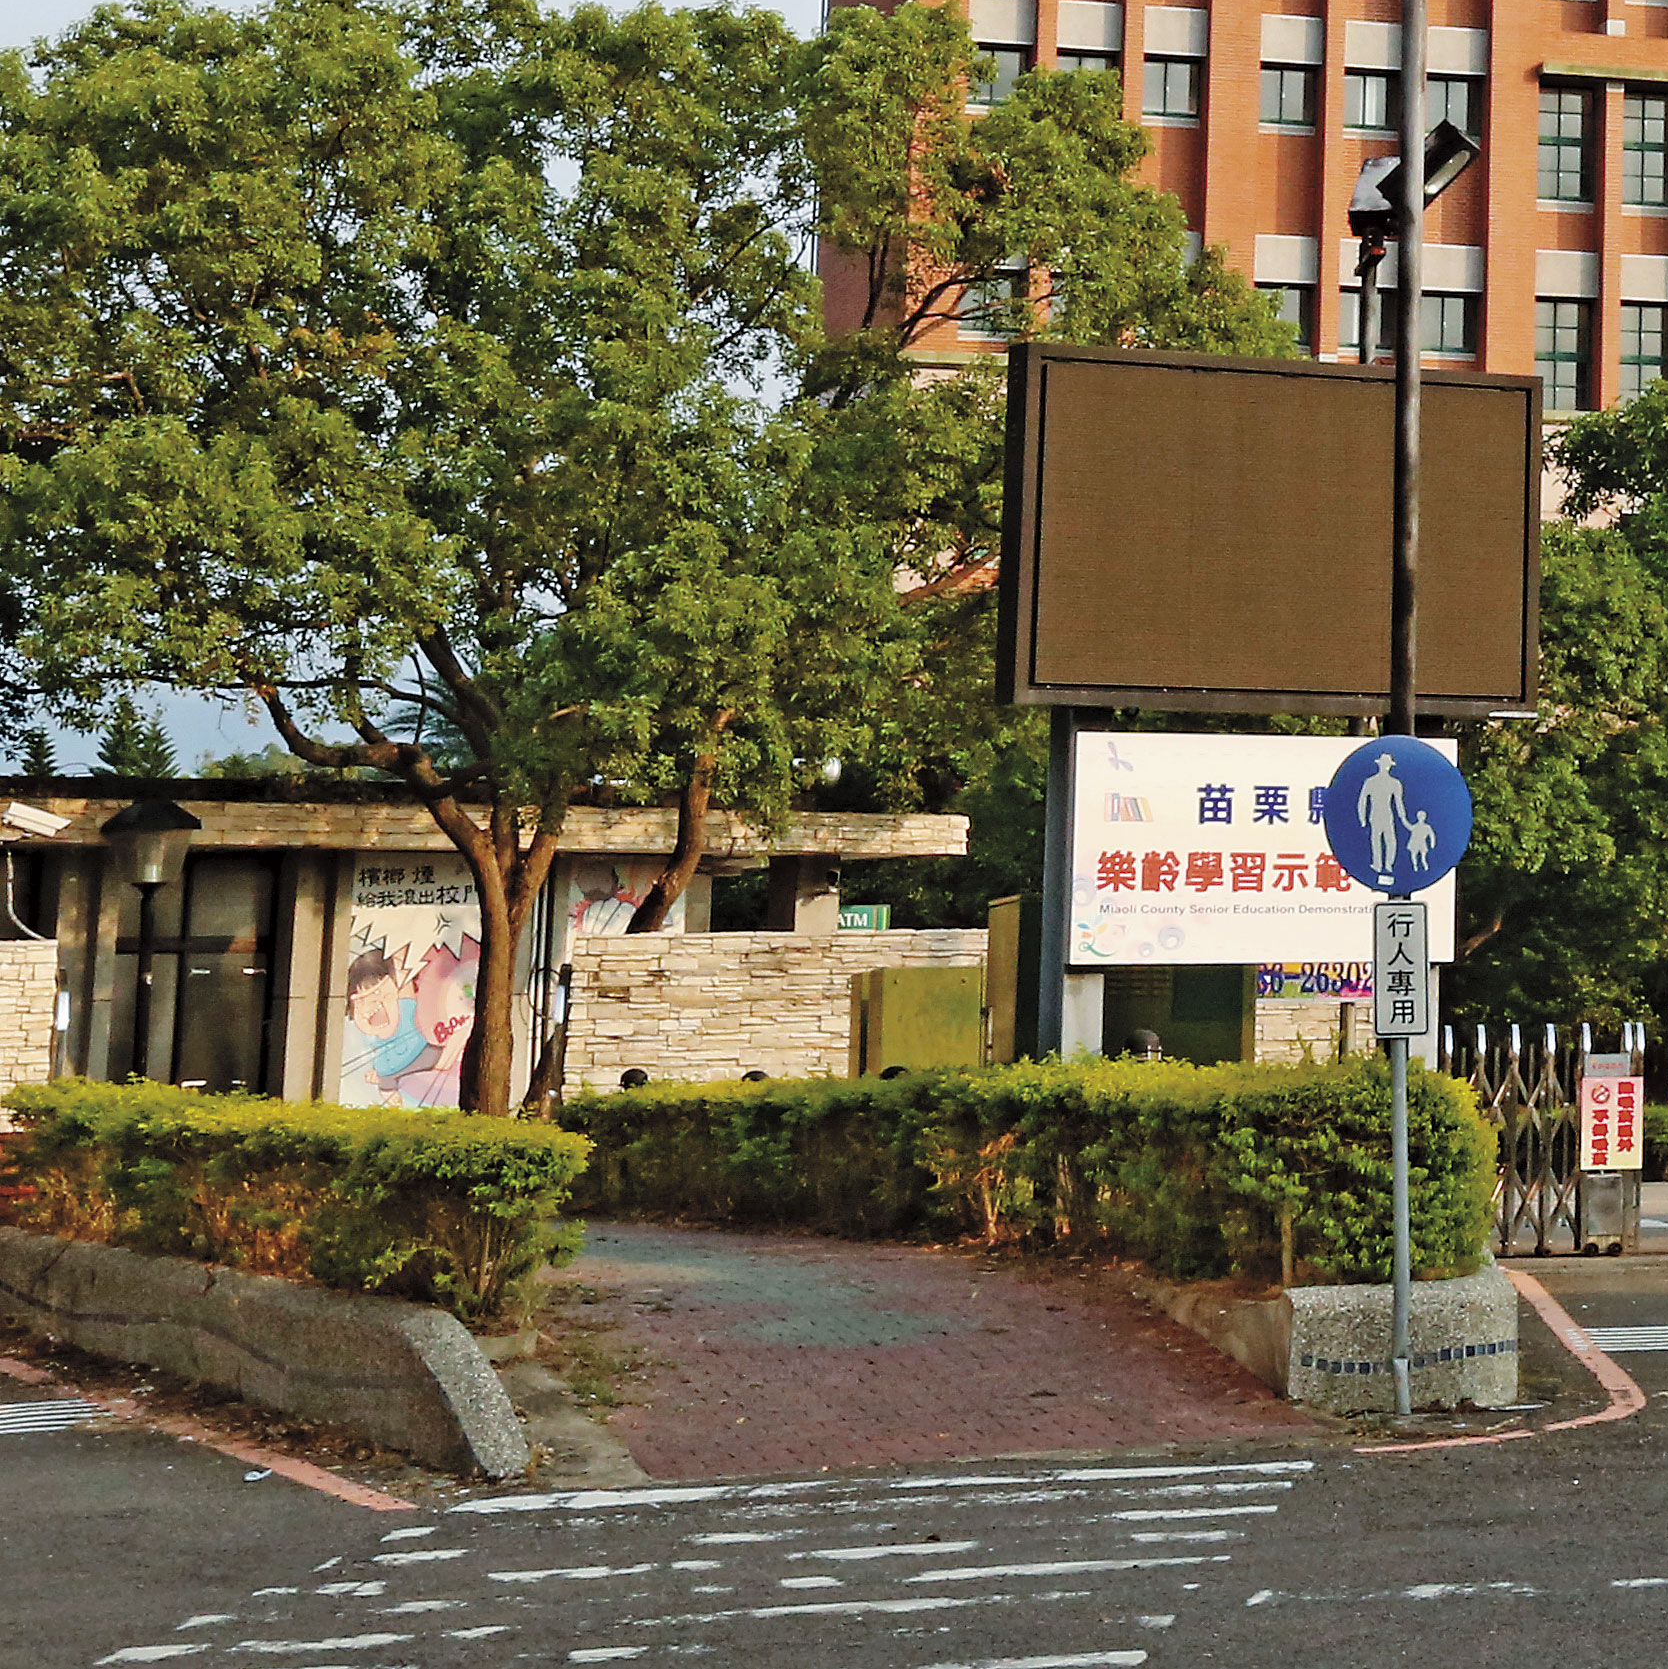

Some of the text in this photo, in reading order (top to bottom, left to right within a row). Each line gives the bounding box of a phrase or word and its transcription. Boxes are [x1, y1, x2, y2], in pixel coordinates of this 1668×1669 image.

[1099, 904, 1137, 914] Miaoli
[1140, 904, 1185, 916] County
[1189, 904, 1229, 914] Senior
[1233, 904, 1295, 914] Education
[1386, 912, 1416, 1025] 行人專用
